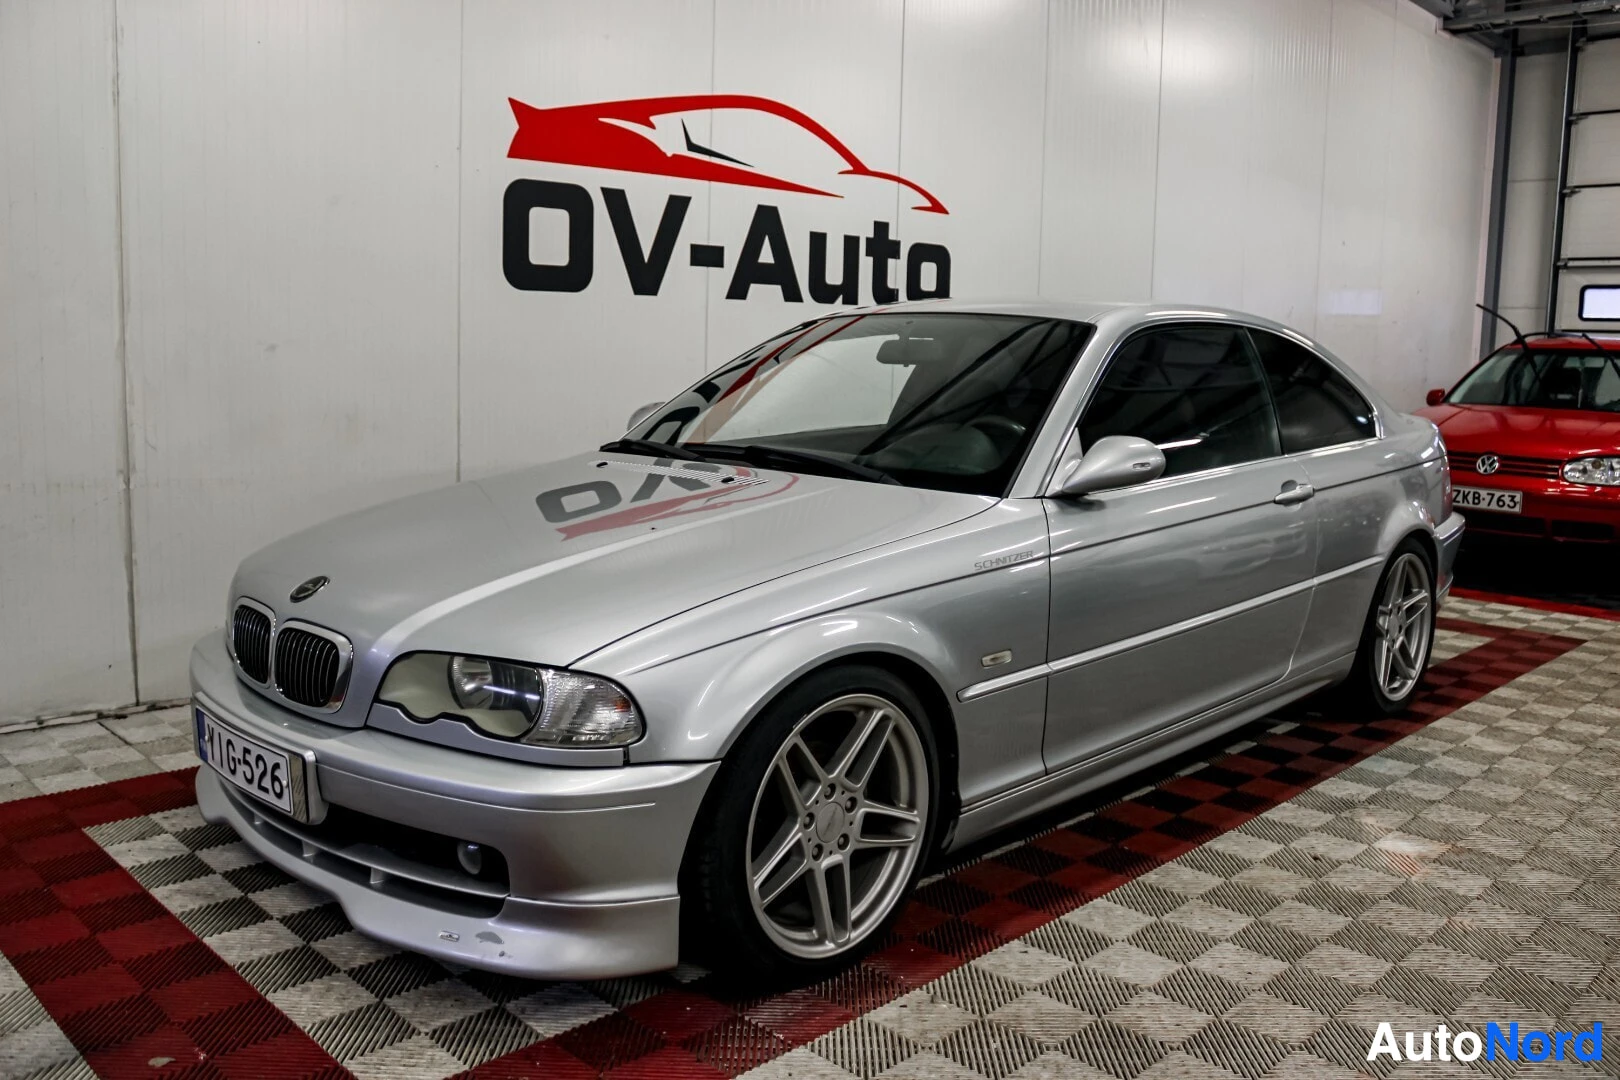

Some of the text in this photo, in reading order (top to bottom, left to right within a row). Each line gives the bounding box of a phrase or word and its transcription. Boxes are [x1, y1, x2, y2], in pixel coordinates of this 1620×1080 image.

[502, 178, 951, 306] OV-Auto
[1452, 489, 1518, 509] ZKB-763
[974, 550, 1034, 571] SCHNITZER
[206, 723, 284, 800] YIG-526
